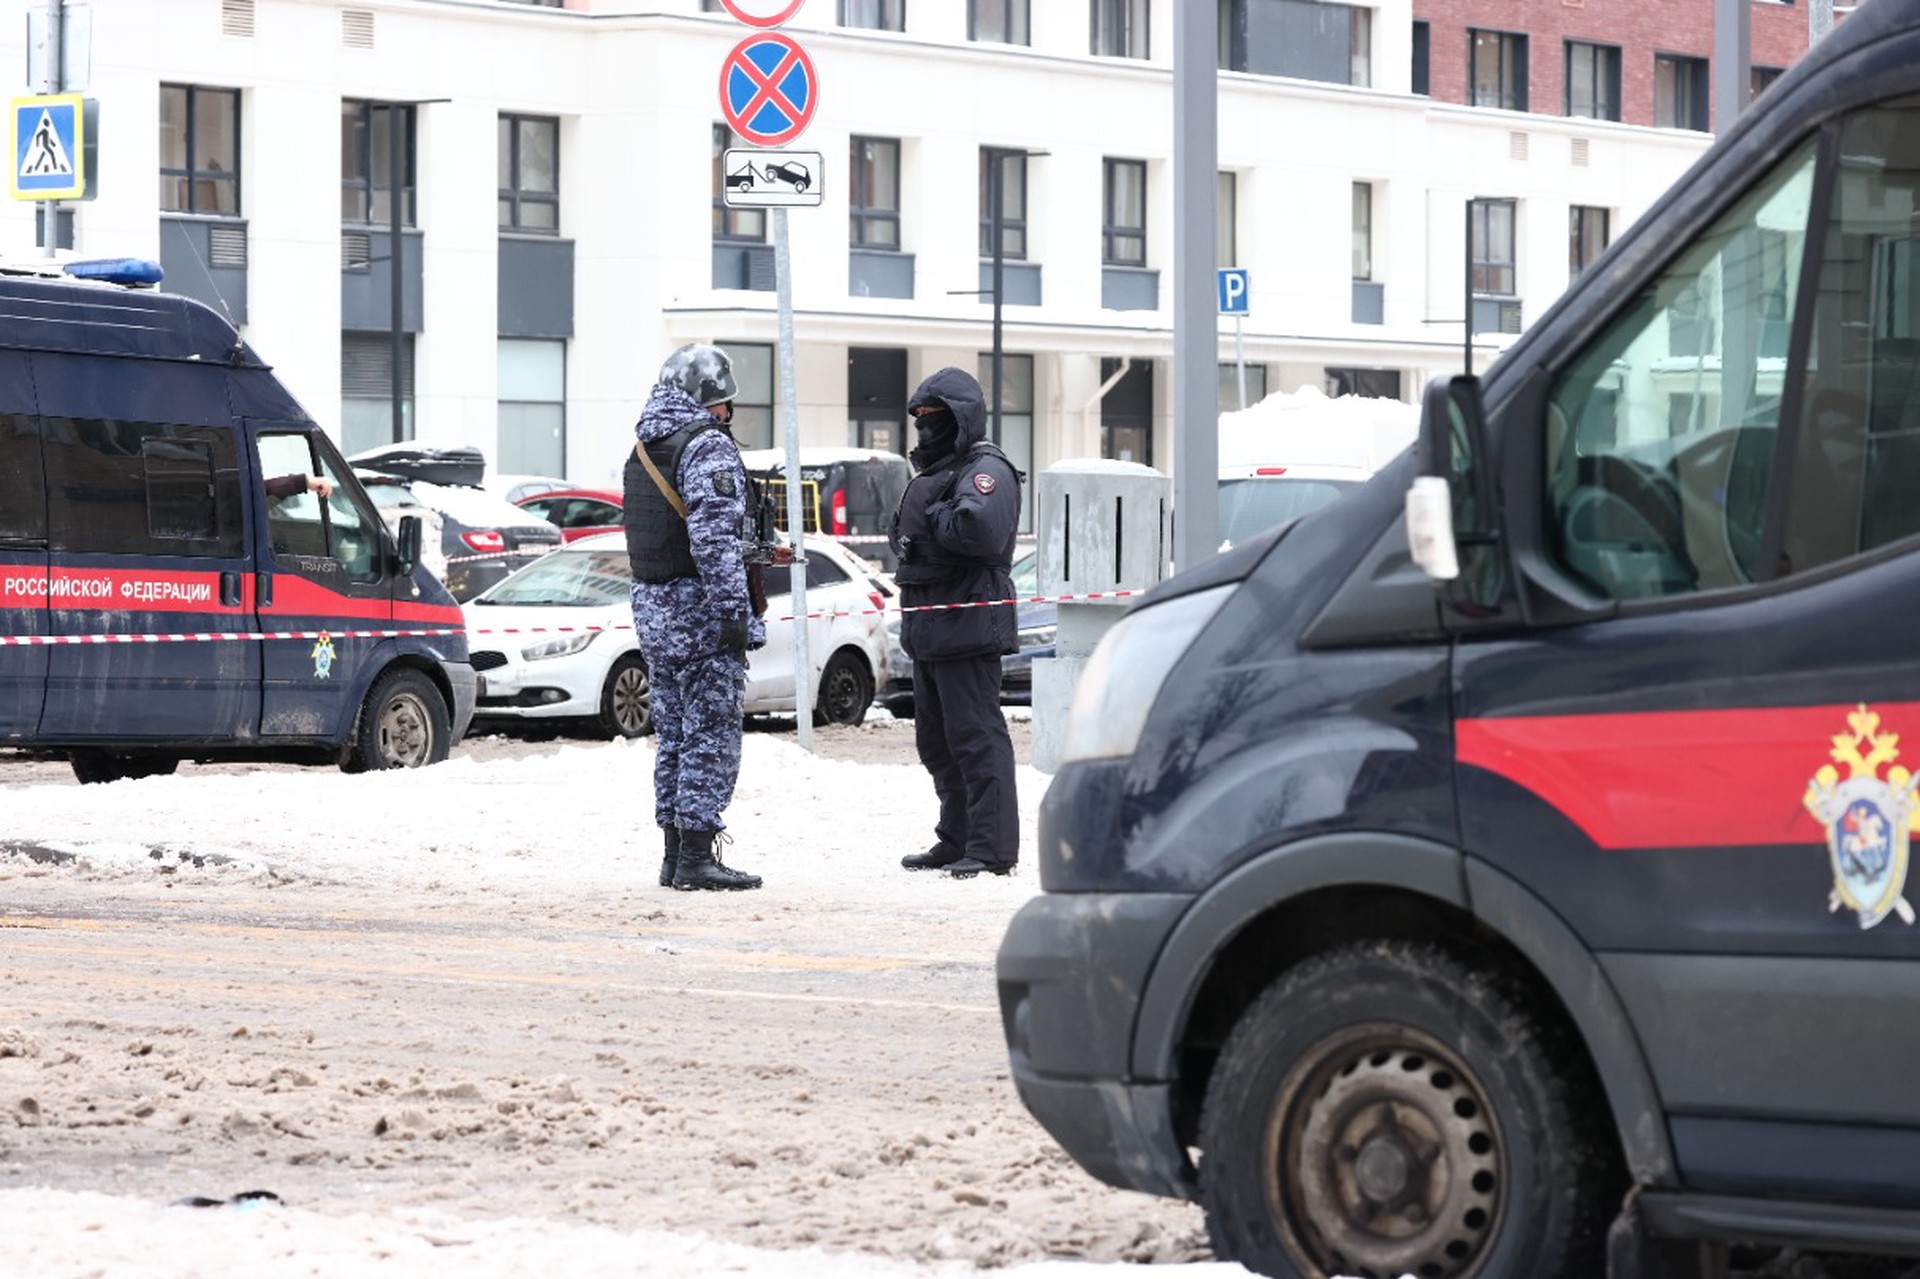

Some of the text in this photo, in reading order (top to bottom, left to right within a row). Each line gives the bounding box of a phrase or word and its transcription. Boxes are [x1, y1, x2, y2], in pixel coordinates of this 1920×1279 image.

[1226, 273, 1244, 309] P
[300, 561, 337, 572] TRANSIT
[5, 576, 211, 603] РОССИЙСКОЙ ФЕДЕРАЦИИ
